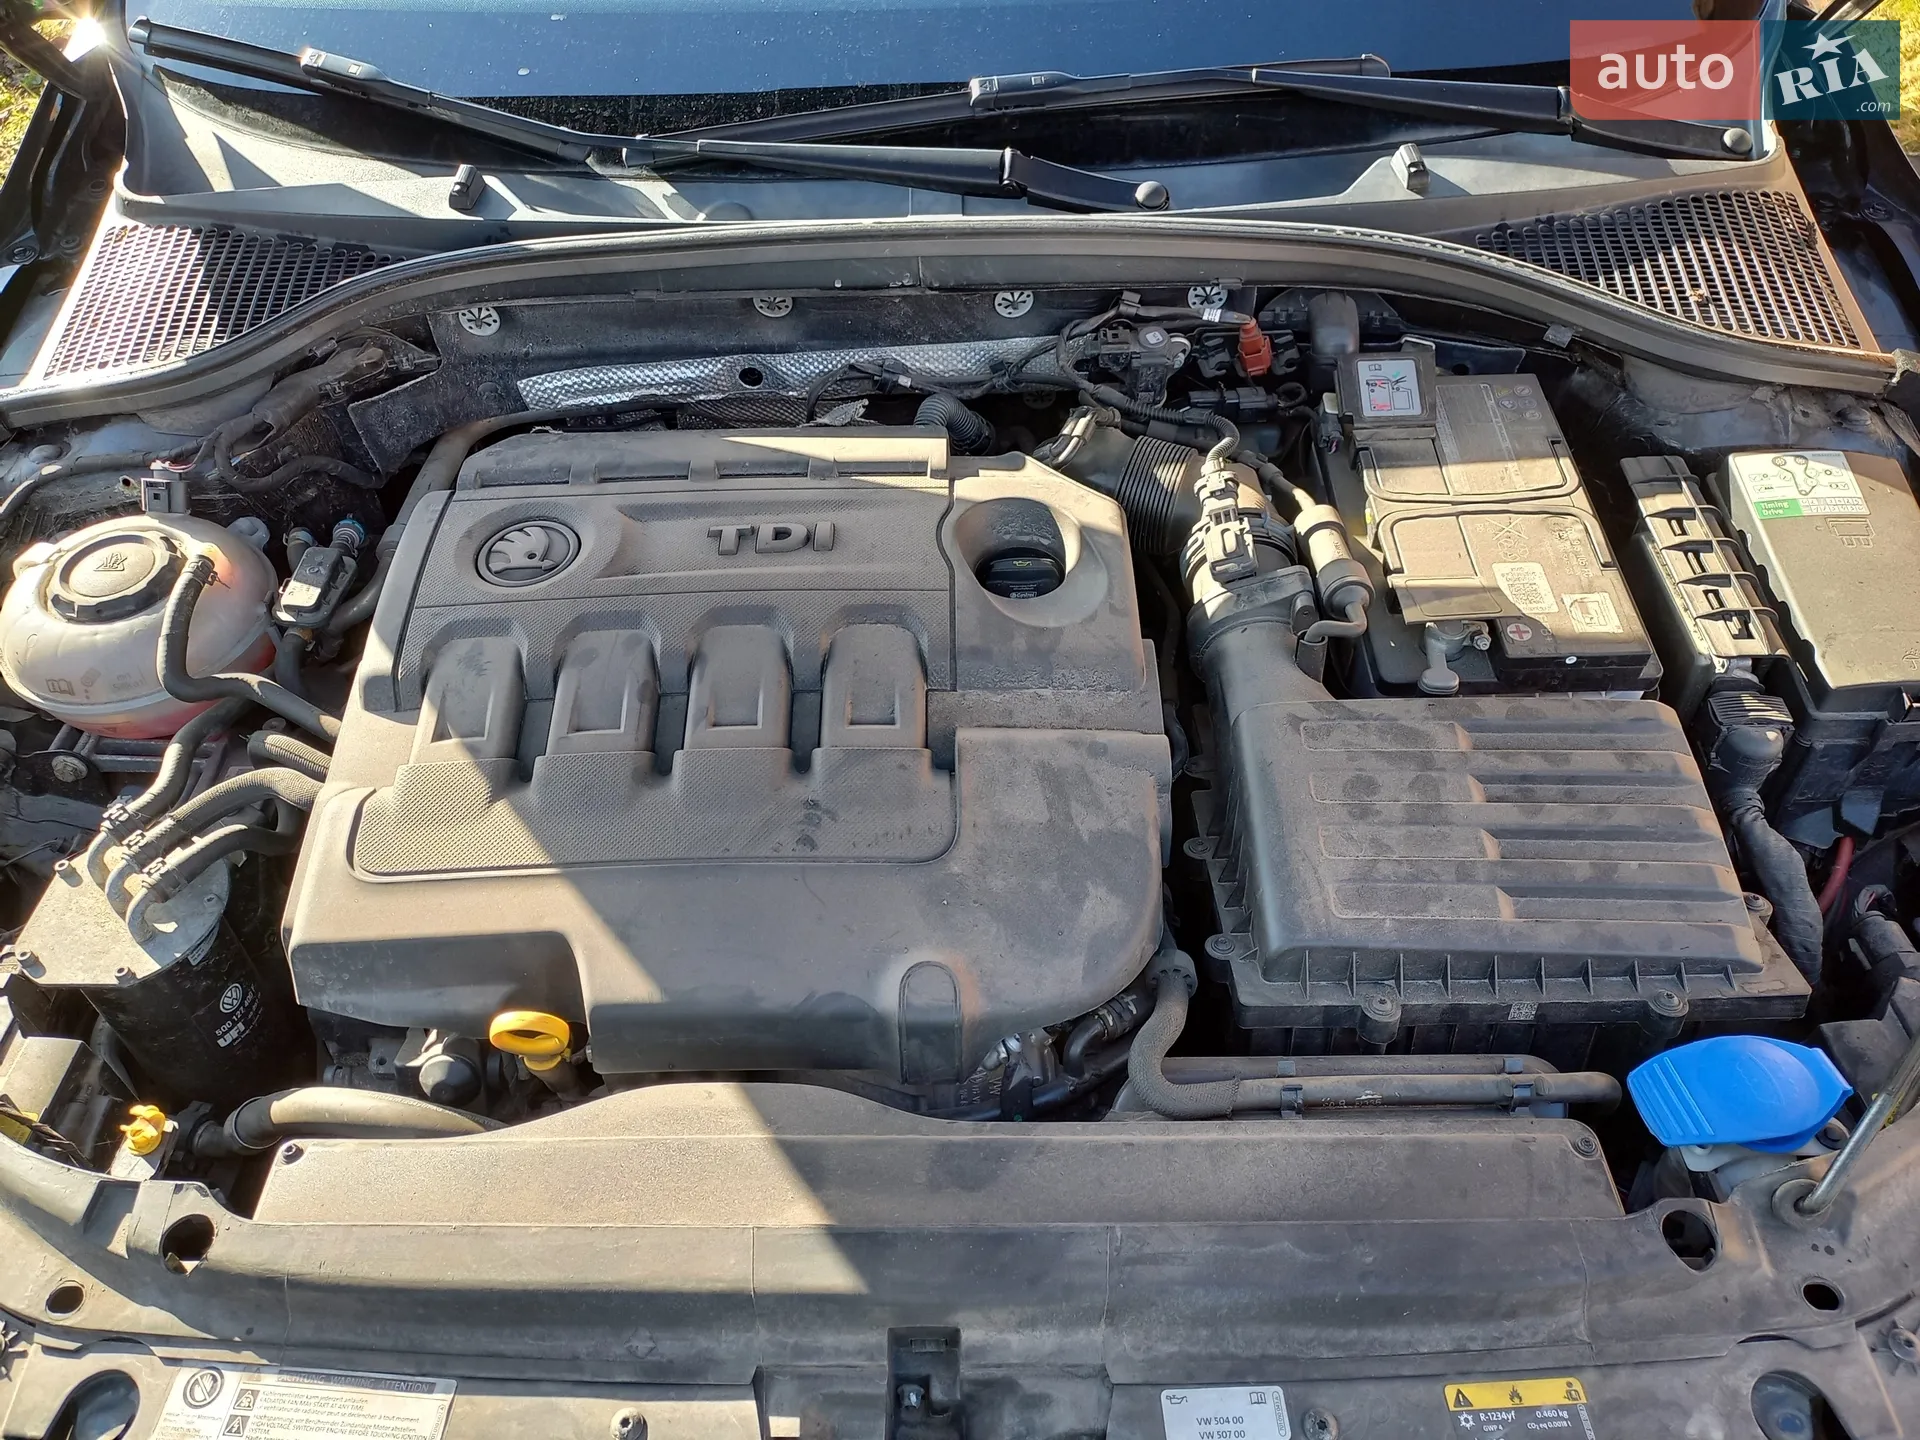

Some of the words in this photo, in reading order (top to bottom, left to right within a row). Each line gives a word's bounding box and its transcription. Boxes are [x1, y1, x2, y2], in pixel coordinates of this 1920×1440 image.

[1760, 501, 1789, 510] Timing
[707, 521, 835, 555] TDI
[232, 1006, 245, 1021] 127
[217, 1021, 245, 1047] UFI
[278, 1371, 326, 1384] ACHTUNG
[330, 1374, 375, 1388] WARNING
[379, 1380, 429, 1392] ATTENTION
[1479, 1410, 1516, 1422] R-1234yf
[1535, 1410, 1558, 1418] 0.460
[1558, 1409, 1569, 1418] kg
[1196, 1418, 1212, 1426] VW
[1214, 1416, 1230, 1425] 504
[1232, 1416, 1244, 1424] 00
[292, 1424, 314, 1432] SWITCH
[326, 1427, 349, 1435] ENGINE
[350, 1429, 369, 1437] BEFORE
[1198, 1431, 1214, 1440] VW
[1216, 1430, 1232, 1439] 507
[1233, 1429, 1246, 1438] 00
